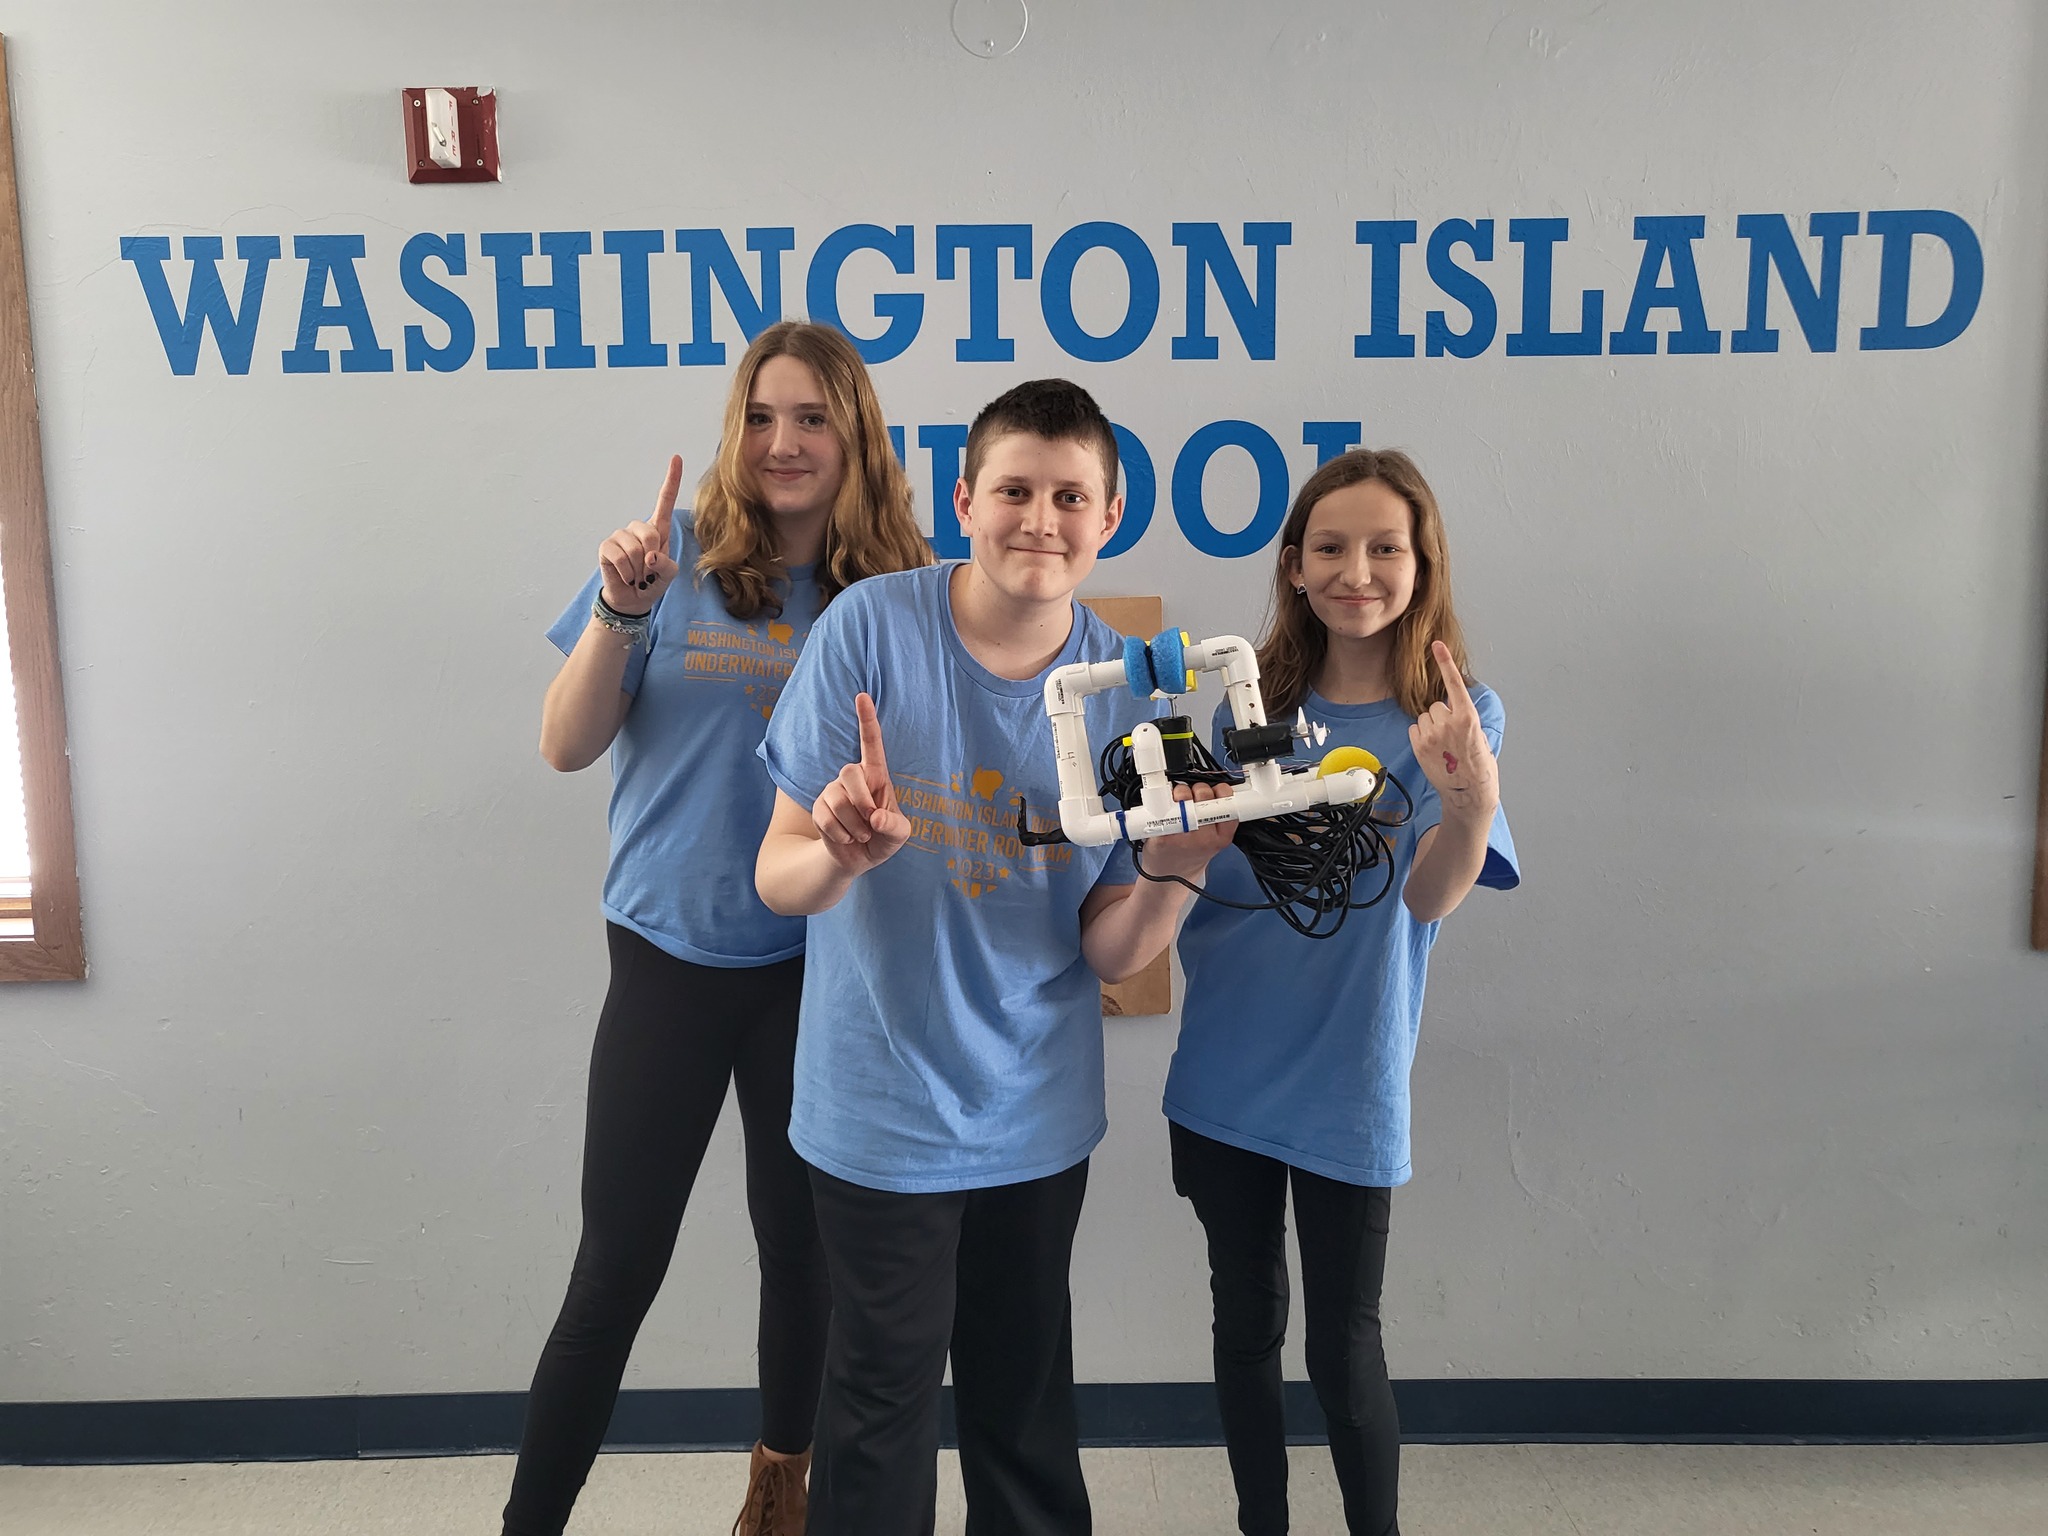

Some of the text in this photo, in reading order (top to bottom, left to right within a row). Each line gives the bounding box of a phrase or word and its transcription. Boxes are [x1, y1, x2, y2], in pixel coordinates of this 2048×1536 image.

[448, 100, 457, 157] FIRE
[119, 209, 1984, 376] WASHINGTON ISLAND
[687, 629, 799, 660] WASHINGTON ISL
[684, 651, 794, 680] UNDERWATER
[757, 683, 779, 701] 20
[894, 785, 974, 822] WASHINTON
[977, 805, 1019, 829] ISLAN
[905, 813, 989, 855] DERWTER
[993, 834, 1027, 860] ROV
[957, 856, 995, 880] 023
